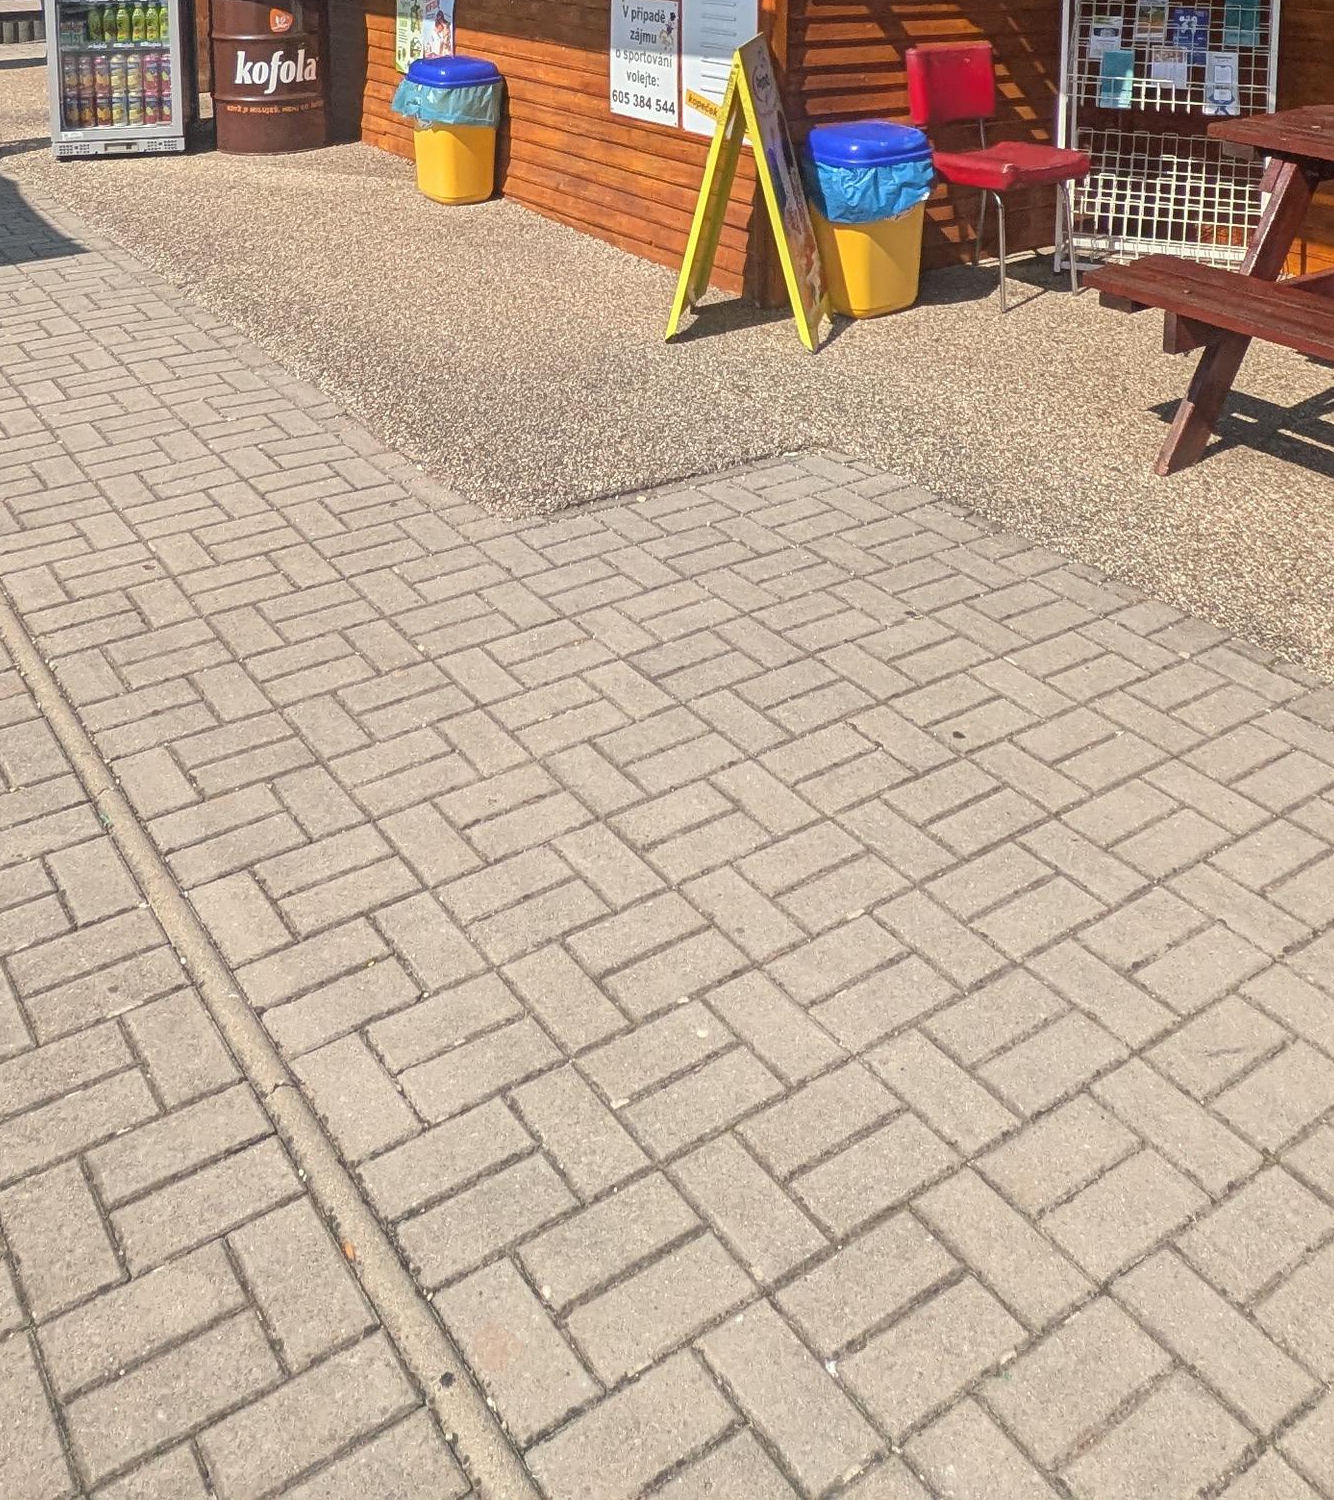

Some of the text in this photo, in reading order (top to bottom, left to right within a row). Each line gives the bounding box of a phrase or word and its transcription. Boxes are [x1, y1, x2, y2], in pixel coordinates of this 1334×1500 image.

[622, 5, 666, 24] V případě
[630, 29, 657, 45] zájmu
[615, 48, 672, 68] o sportování
[234, 49, 316, 95] kofola
[627, 70, 660, 88] volejte:
[612, 89, 676, 115] 605 384 544
